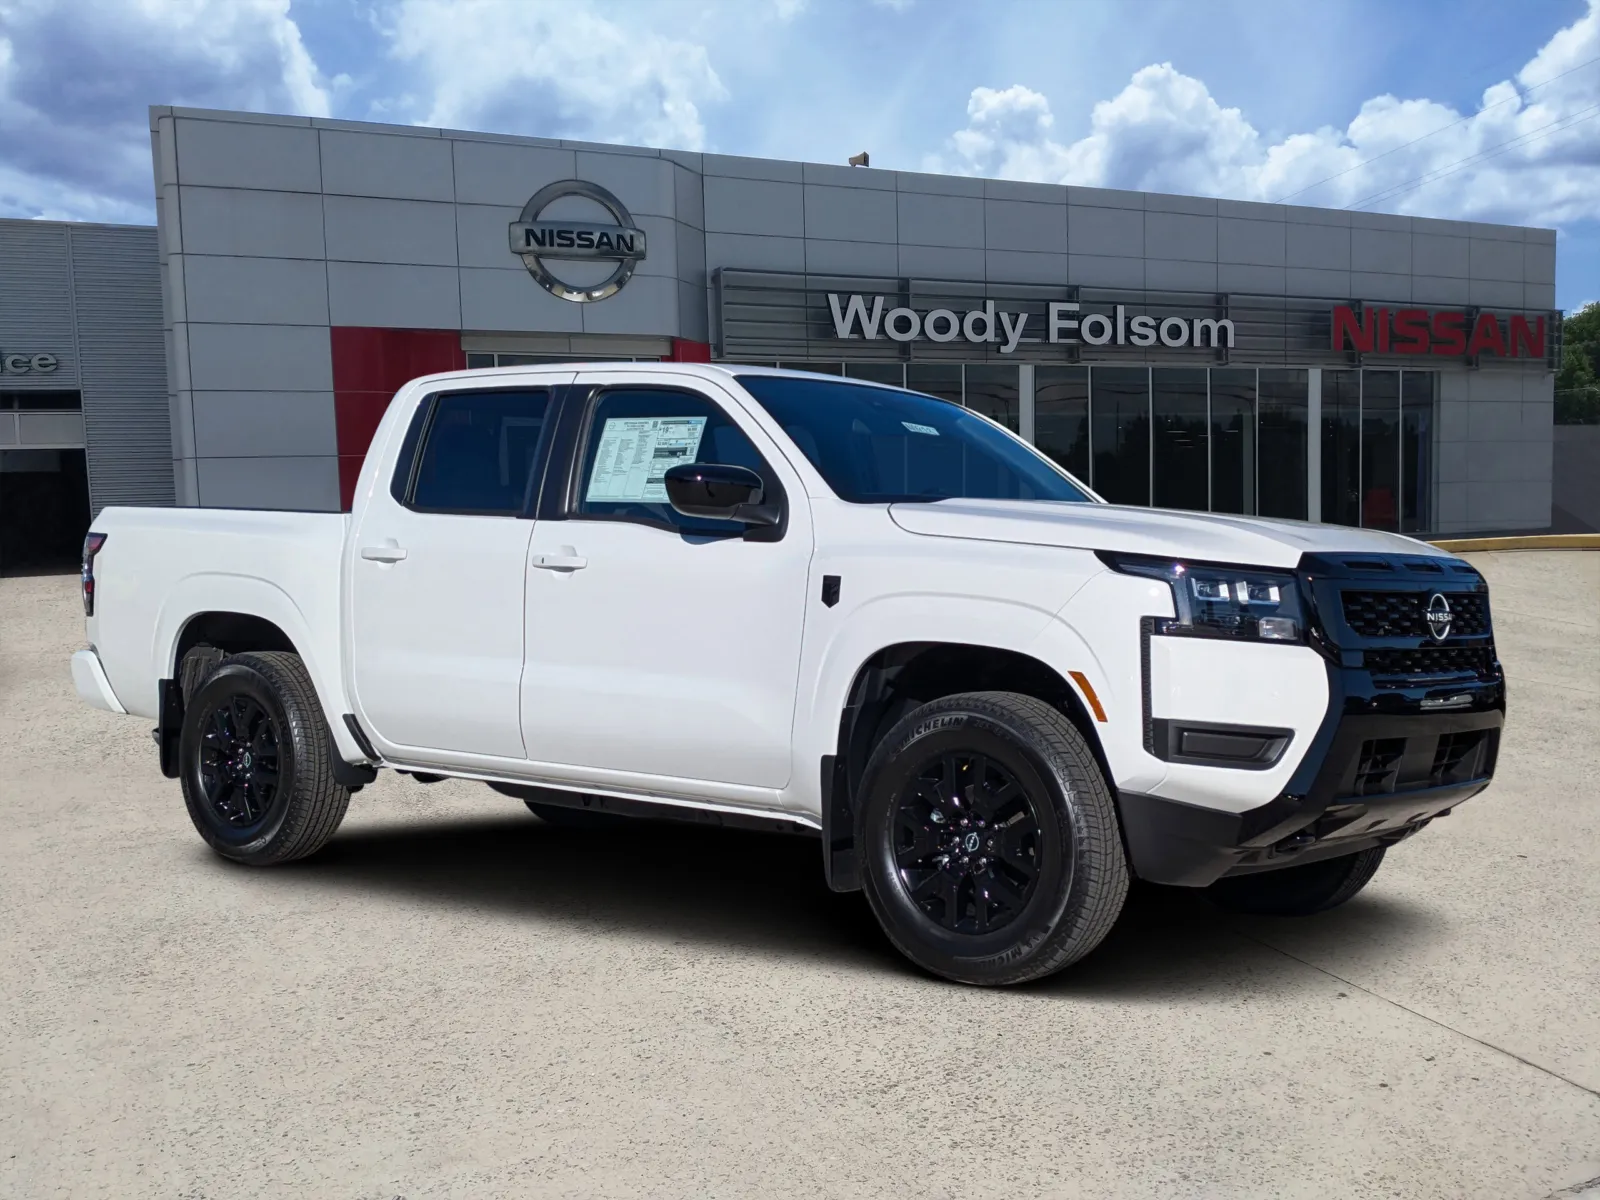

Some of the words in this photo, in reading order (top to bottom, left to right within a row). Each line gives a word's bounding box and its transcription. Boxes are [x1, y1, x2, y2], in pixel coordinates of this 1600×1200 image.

[525, 228, 635, 252] NISSAN
[828, 293, 1028, 353] Woody
[1047, 302, 1236, 348] Folsom
[1333, 305, 1545, 358] NISSAN
[0, 353, 58, 374] ce
[903, 717, 965, 744] MICHELIN
